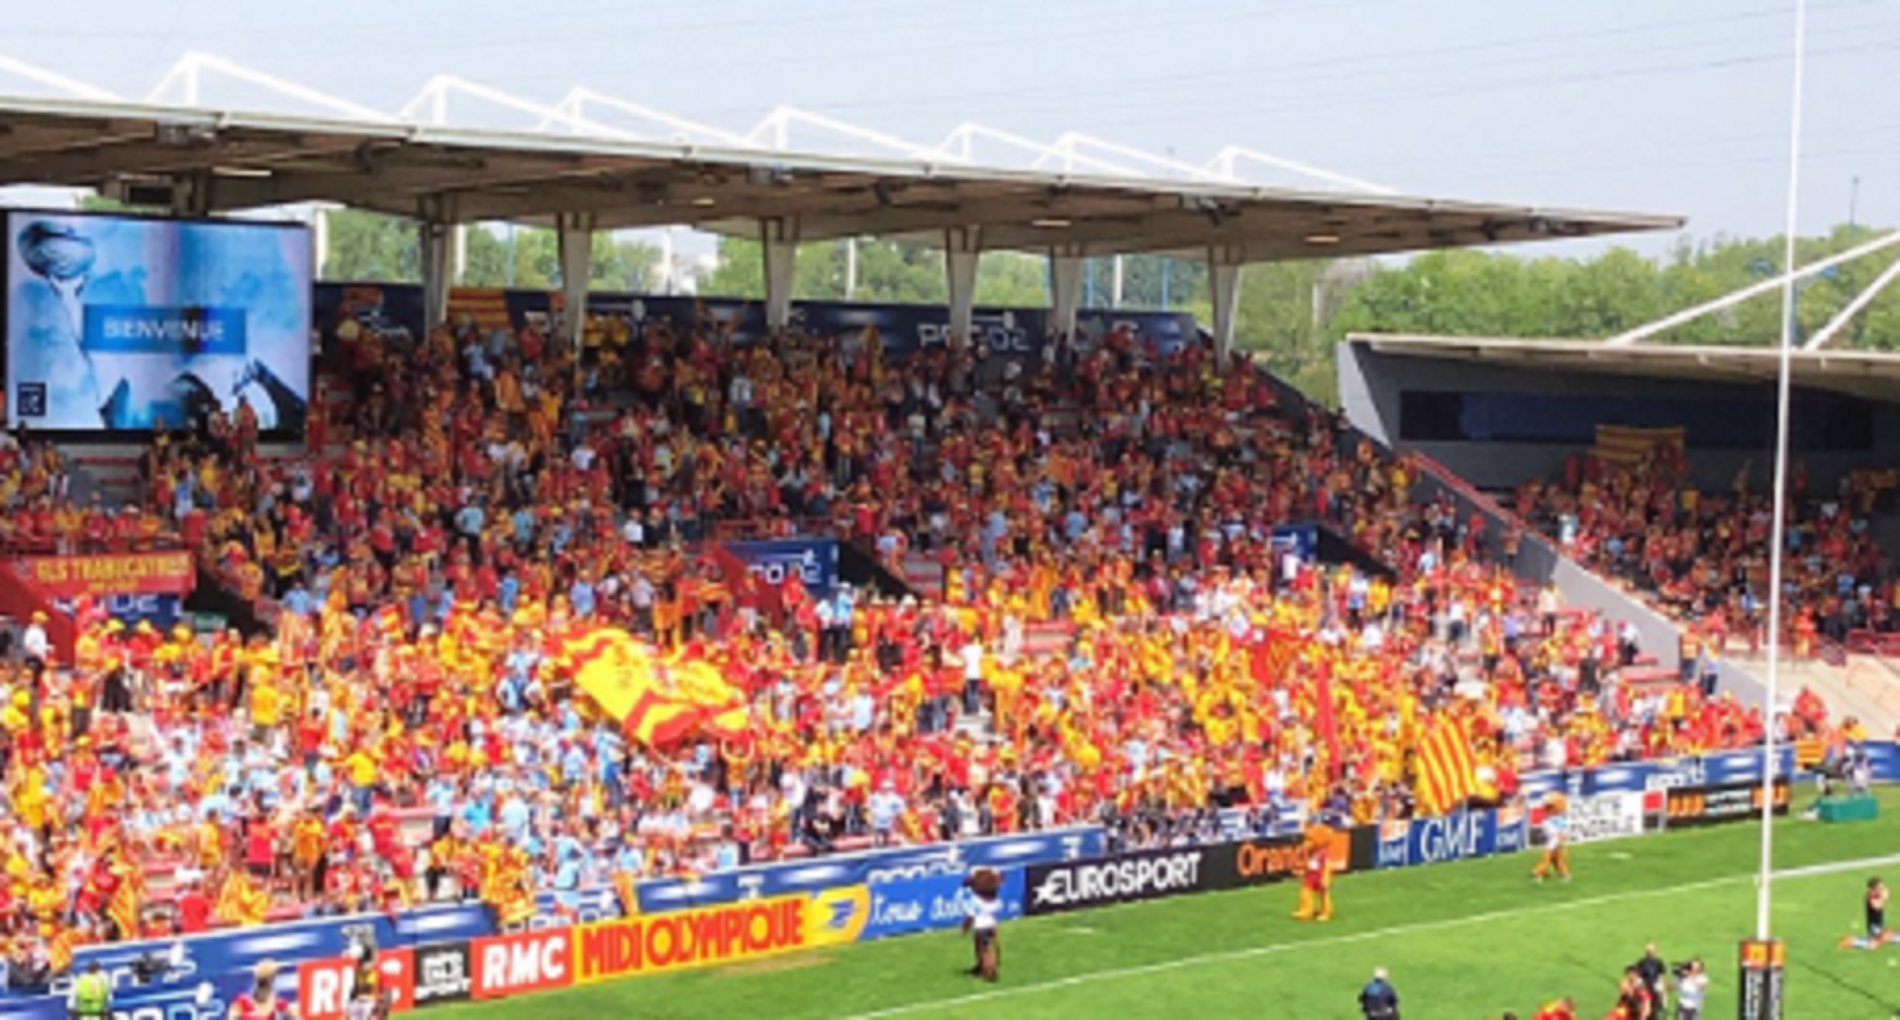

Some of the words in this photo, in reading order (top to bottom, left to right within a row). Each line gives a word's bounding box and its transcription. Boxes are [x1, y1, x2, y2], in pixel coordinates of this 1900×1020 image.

[103, 316, 226, 340] BIENVENUE
[1237, 843, 1310, 877] Orang
[1420, 810, 1488, 863] GMF
[1043, 852, 1202, 905] EUROSPORT
[482, 937, 565, 989] RMC
[582, 922, 642, 977] MIDI
[645, 898, 804, 966] OLYMPIQUE
